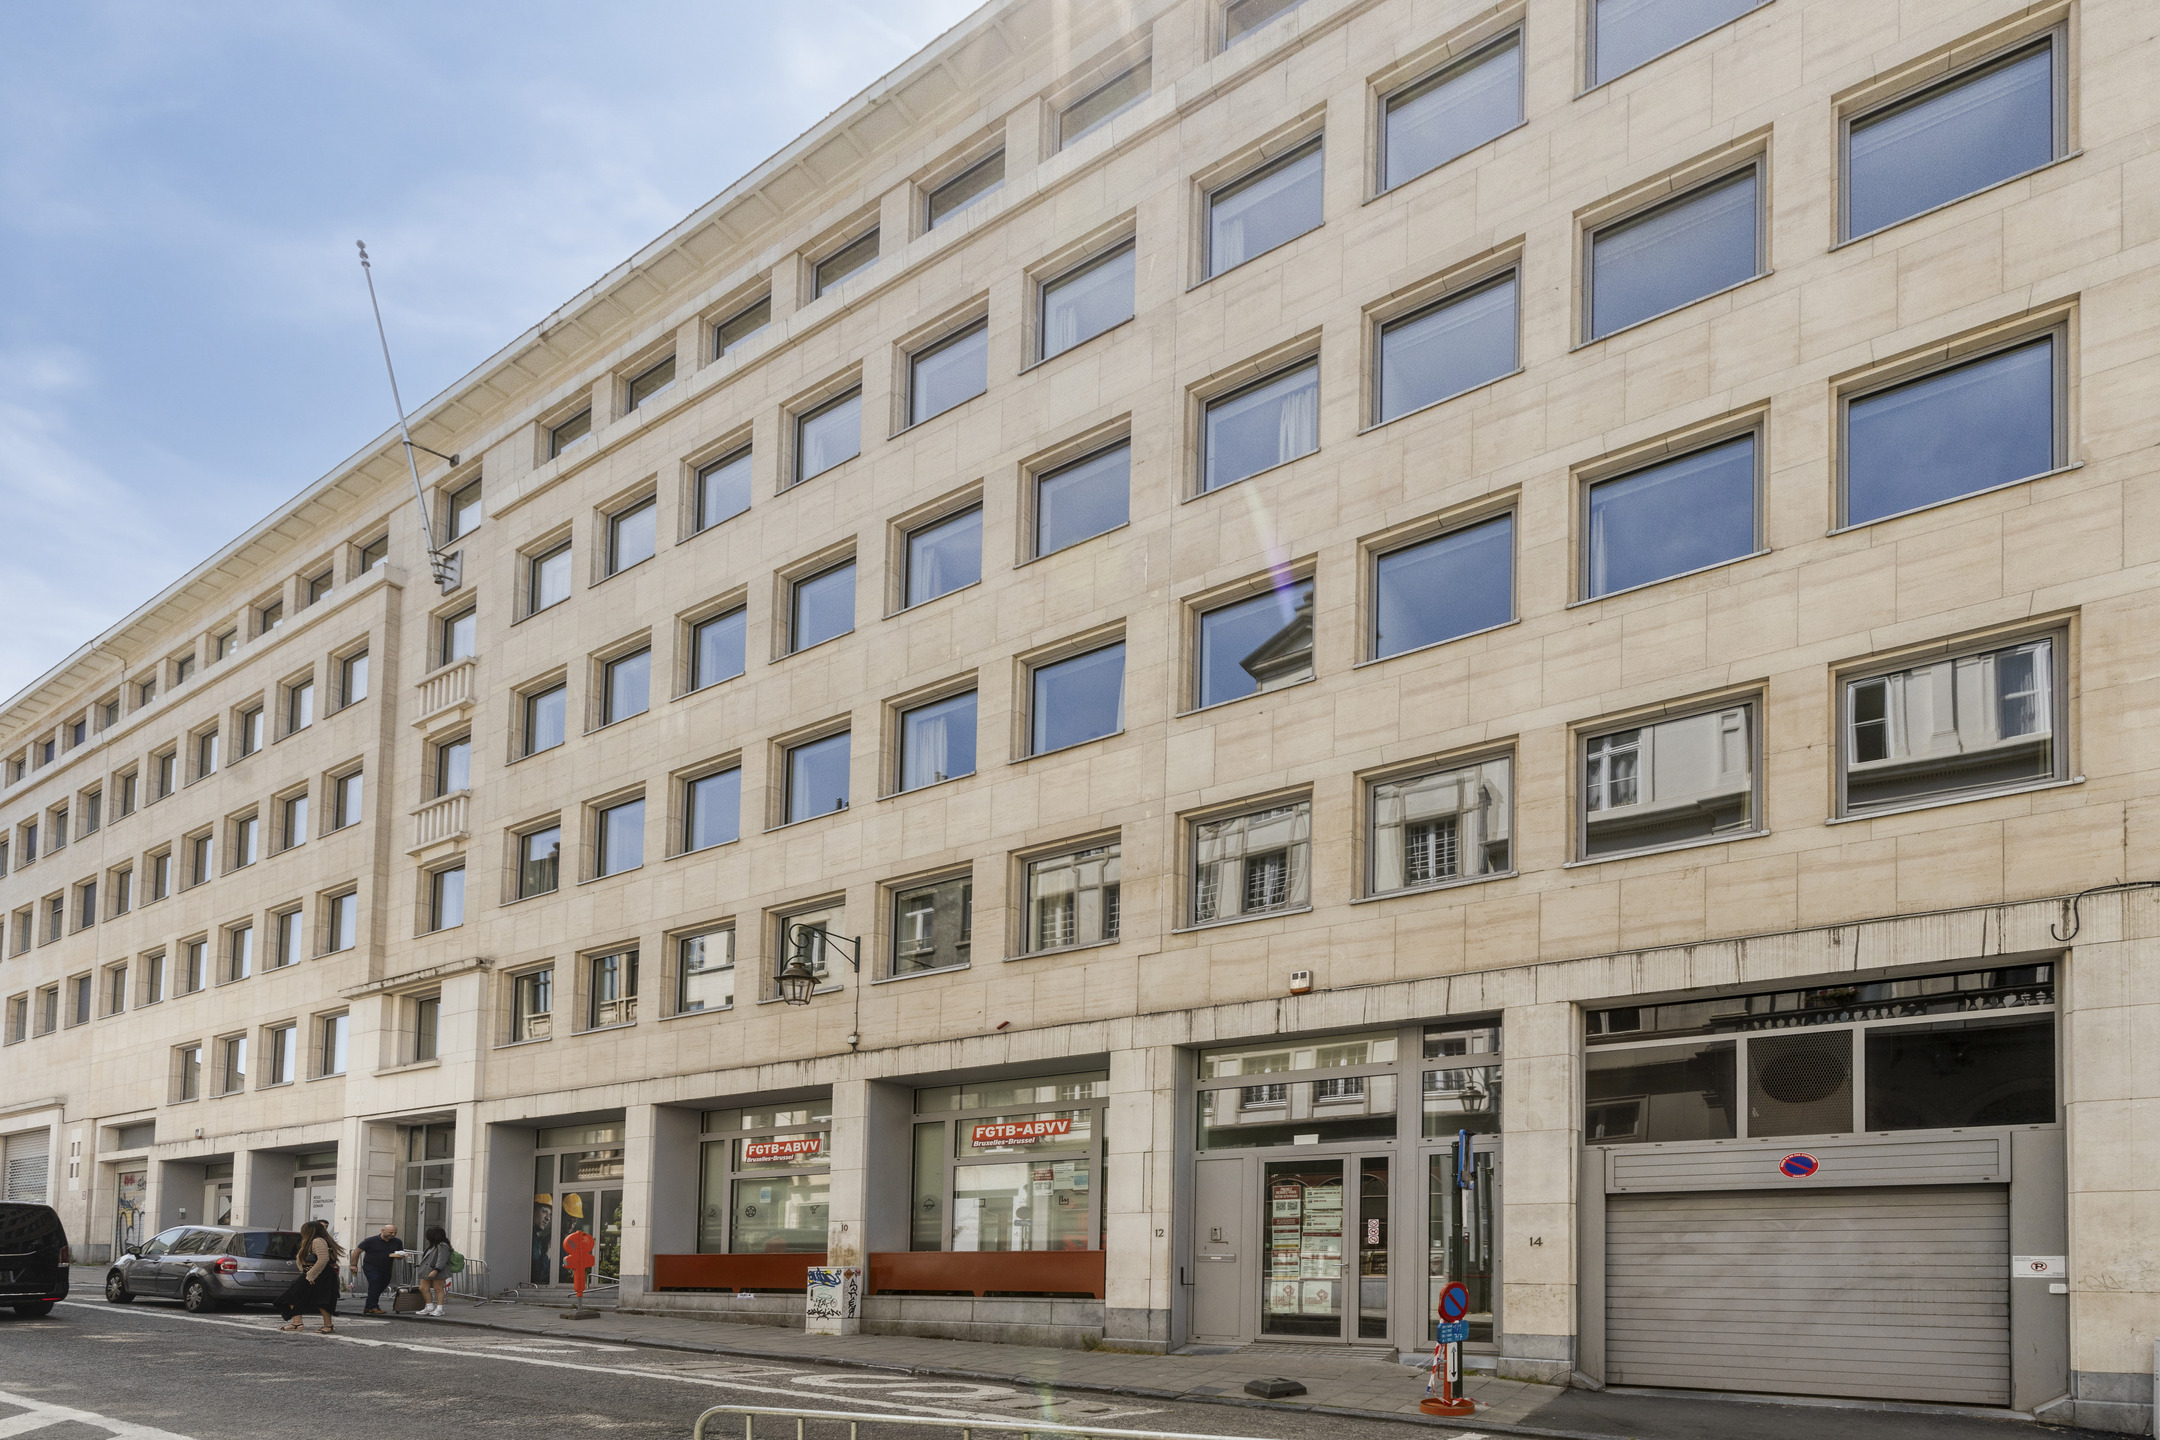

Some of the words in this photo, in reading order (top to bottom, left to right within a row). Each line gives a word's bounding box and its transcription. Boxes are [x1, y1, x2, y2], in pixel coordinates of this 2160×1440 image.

[976, 1120, 1068, 1138] FGTB-ABVV
[973, 1136, 1036, 1147] Bruxelles-Brussel
[748, 1140, 819, 1155] FGTB-ABVV
[746, 1154, 794, 1163] Bruxelles-Brussel
[841, 1224, 848, 1232] 10
[1155, 1228, 1164, 1237] 12
[1529, 1236, 1543, 1246] 14
